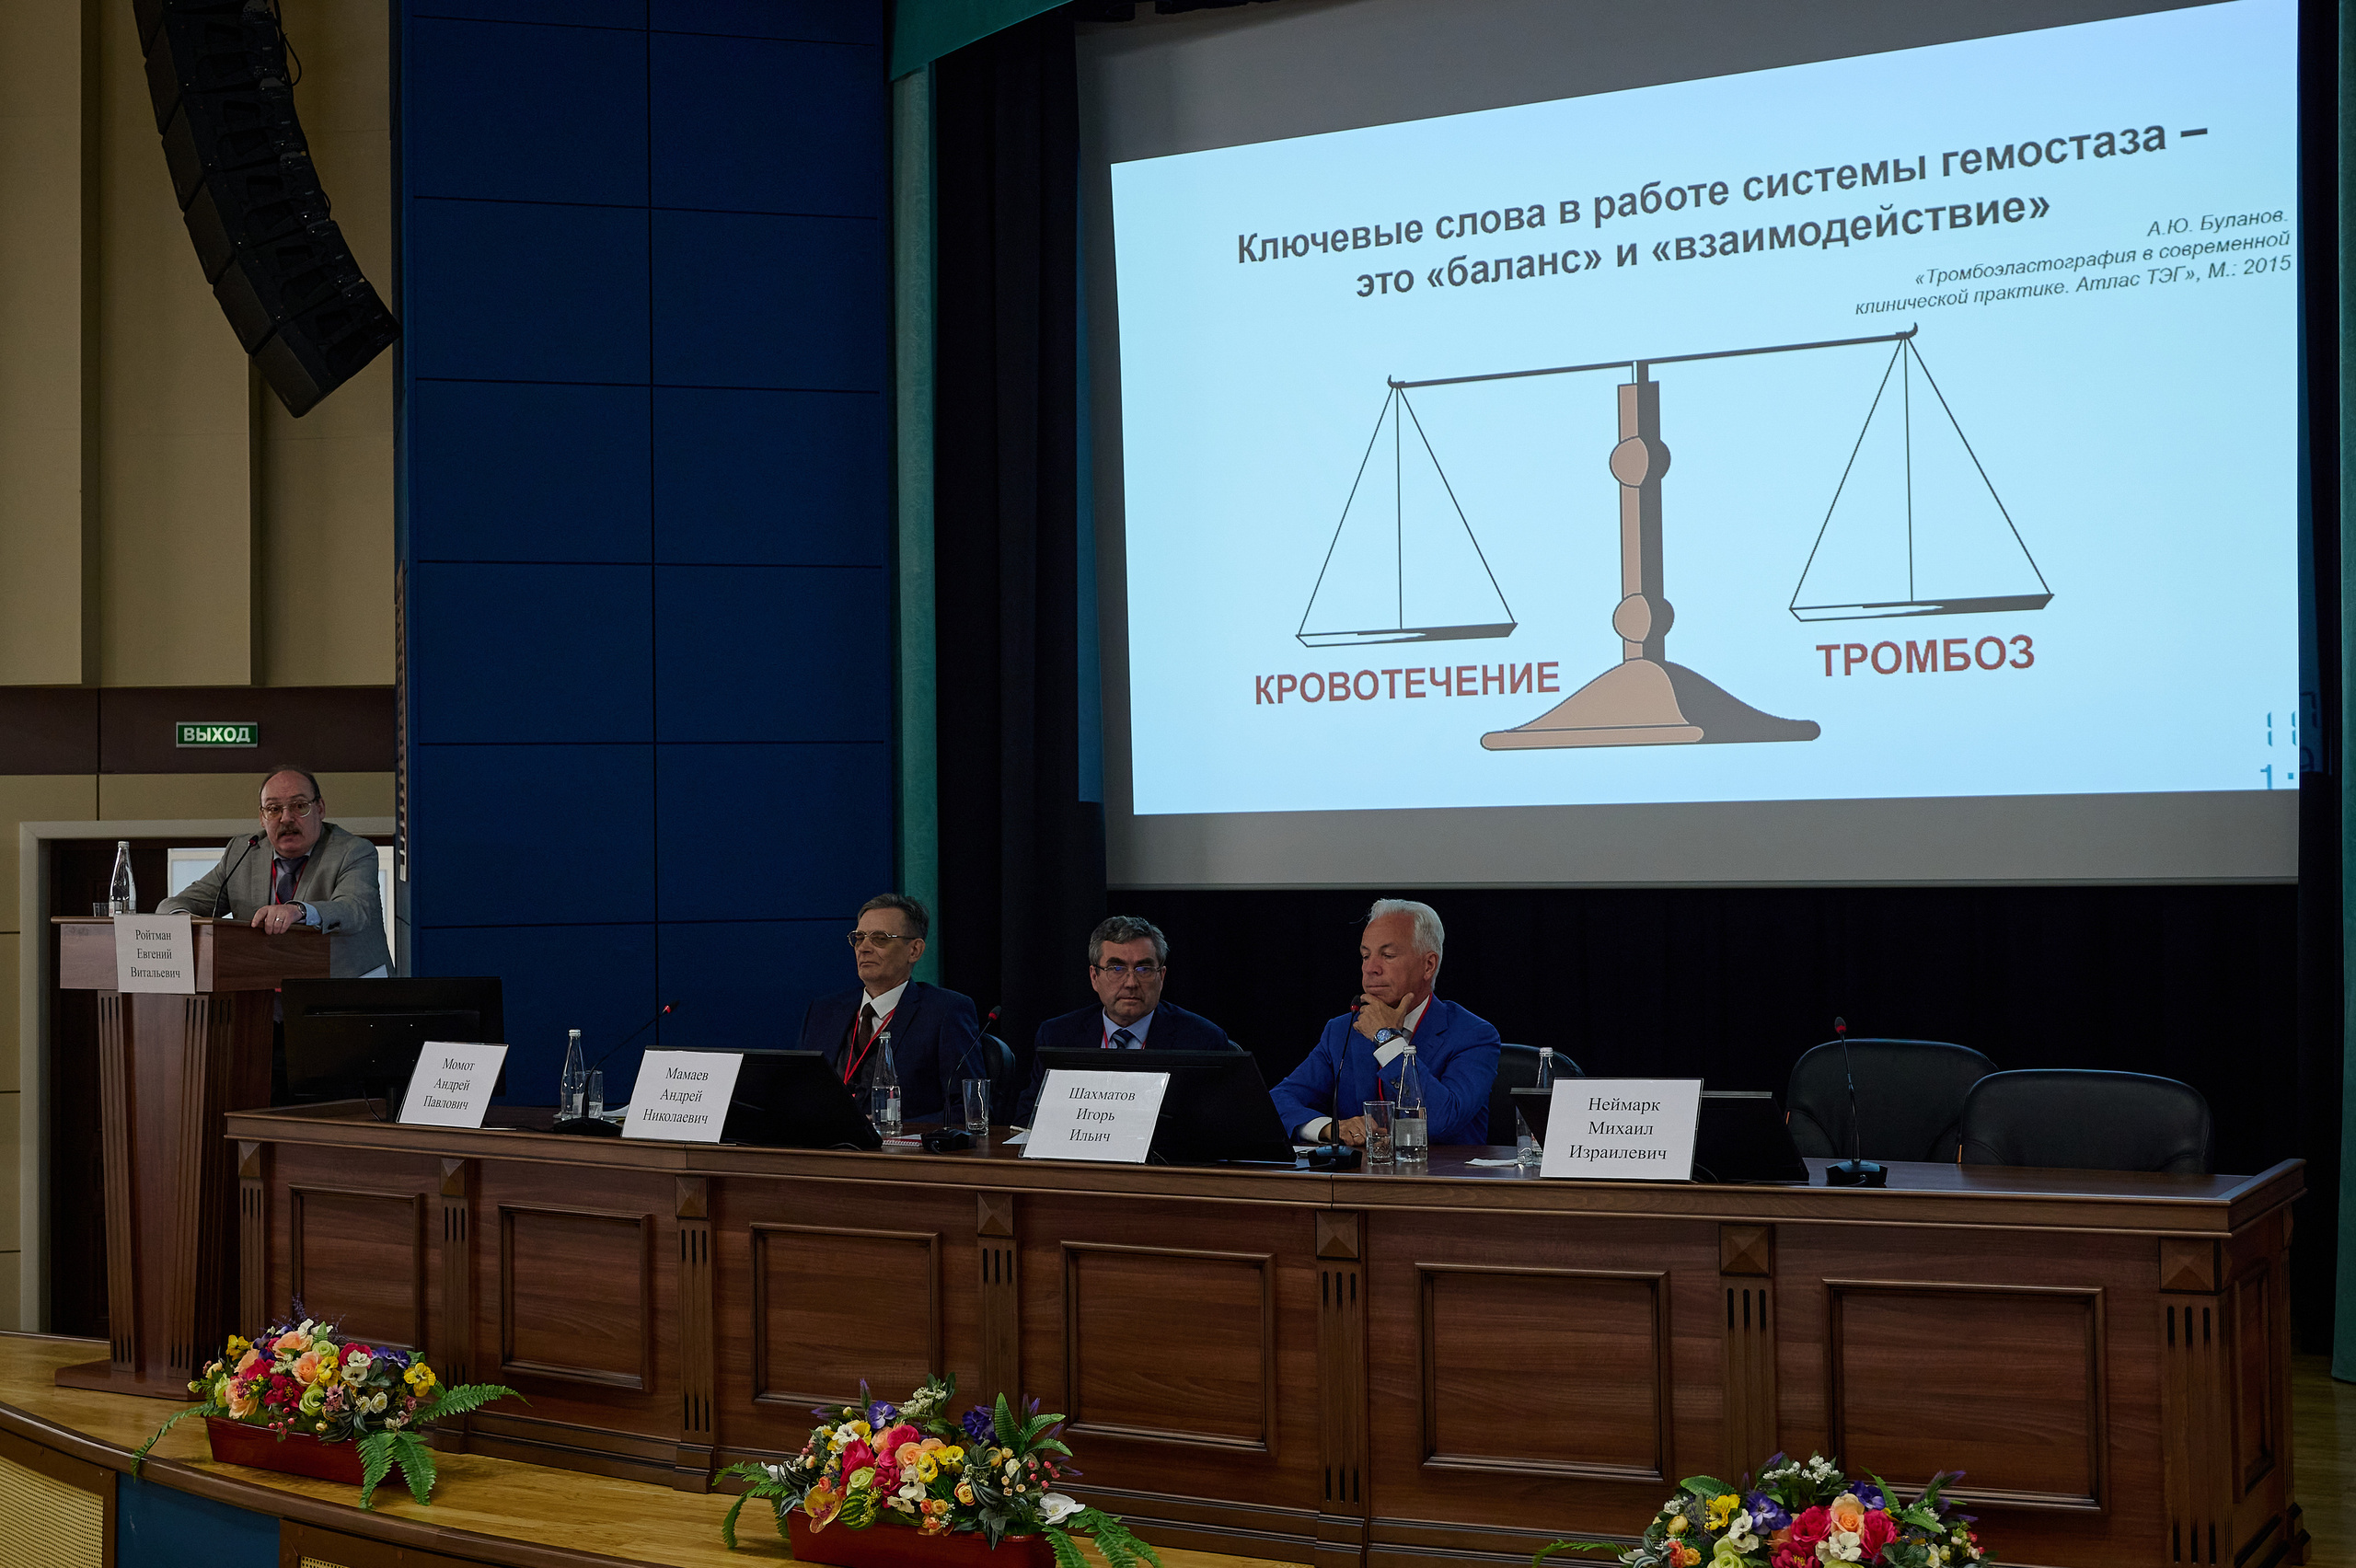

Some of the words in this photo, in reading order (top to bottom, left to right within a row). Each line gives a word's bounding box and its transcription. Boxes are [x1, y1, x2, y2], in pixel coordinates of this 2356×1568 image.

[1239, 220, 1423, 263] Ключевые
[1436, 204, 1545, 239] слова
[1560, 201, 1580, 224] в
[1595, 180, 1728, 228] работе
[1743, 156, 1925, 202] системы
[1943, 125, 2166, 177] гемостаза
[2147, 218, 2192, 236] А.Ю.
[2200, 211, 2287, 233] Буланов.
[1357, 270, 1414, 297] это
[1427, 249, 1601, 287] «баланс»
[1617, 243, 1637, 267] и
[1652, 197, 2050, 261] «взаимодействие»
[1915, 249, 2137, 286] «Тромбоэластография
[2142, 249, 2153, 260] в
[2160, 231, 2291, 260] современной
[1856, 284, 1968, 315] клинической
[1974, 282, 2068, 306] практике.
[2074, 271, 2140, 291] Атлас
[2147, 266, 2200, 284] ТЭГ»,
[2244, 255, 2291, 274] 2015
[1816, 634, 2036, 676] ТРОМБОЗ
[1256, 662, 1560, 705] КРОВОТЕЧЕНИЕ
[183, 727, 250, 743] ВЫХОД
[135, 929, 172, 940] Ройтман
[137, 948, 172, 959] Евгений
[131, 966, 180, 978] Витальевич
[442, 1058, 475, 1071] Момот
[665, 1067, 709, 1081] Мамаев
[433, 1078, 470, 1092] Андрей
[660, 1089, 703, 1104] Андрей
[1068, 1087, 1136, 1101] Шахматов
[423, 1095, 468, 1110] Павлович
[1588, 1097, 1661, 1114] Неймарк
[642, 1108, 708, 1124] Николаевич
[1076, 1107, 1115, 1124] Игорь
[1069, 1128, 1111, 1142] Ильич
[1588, 1121, 1654, 1136] Михаил
[1569, 1144, 1668, 1162] Израилевич
